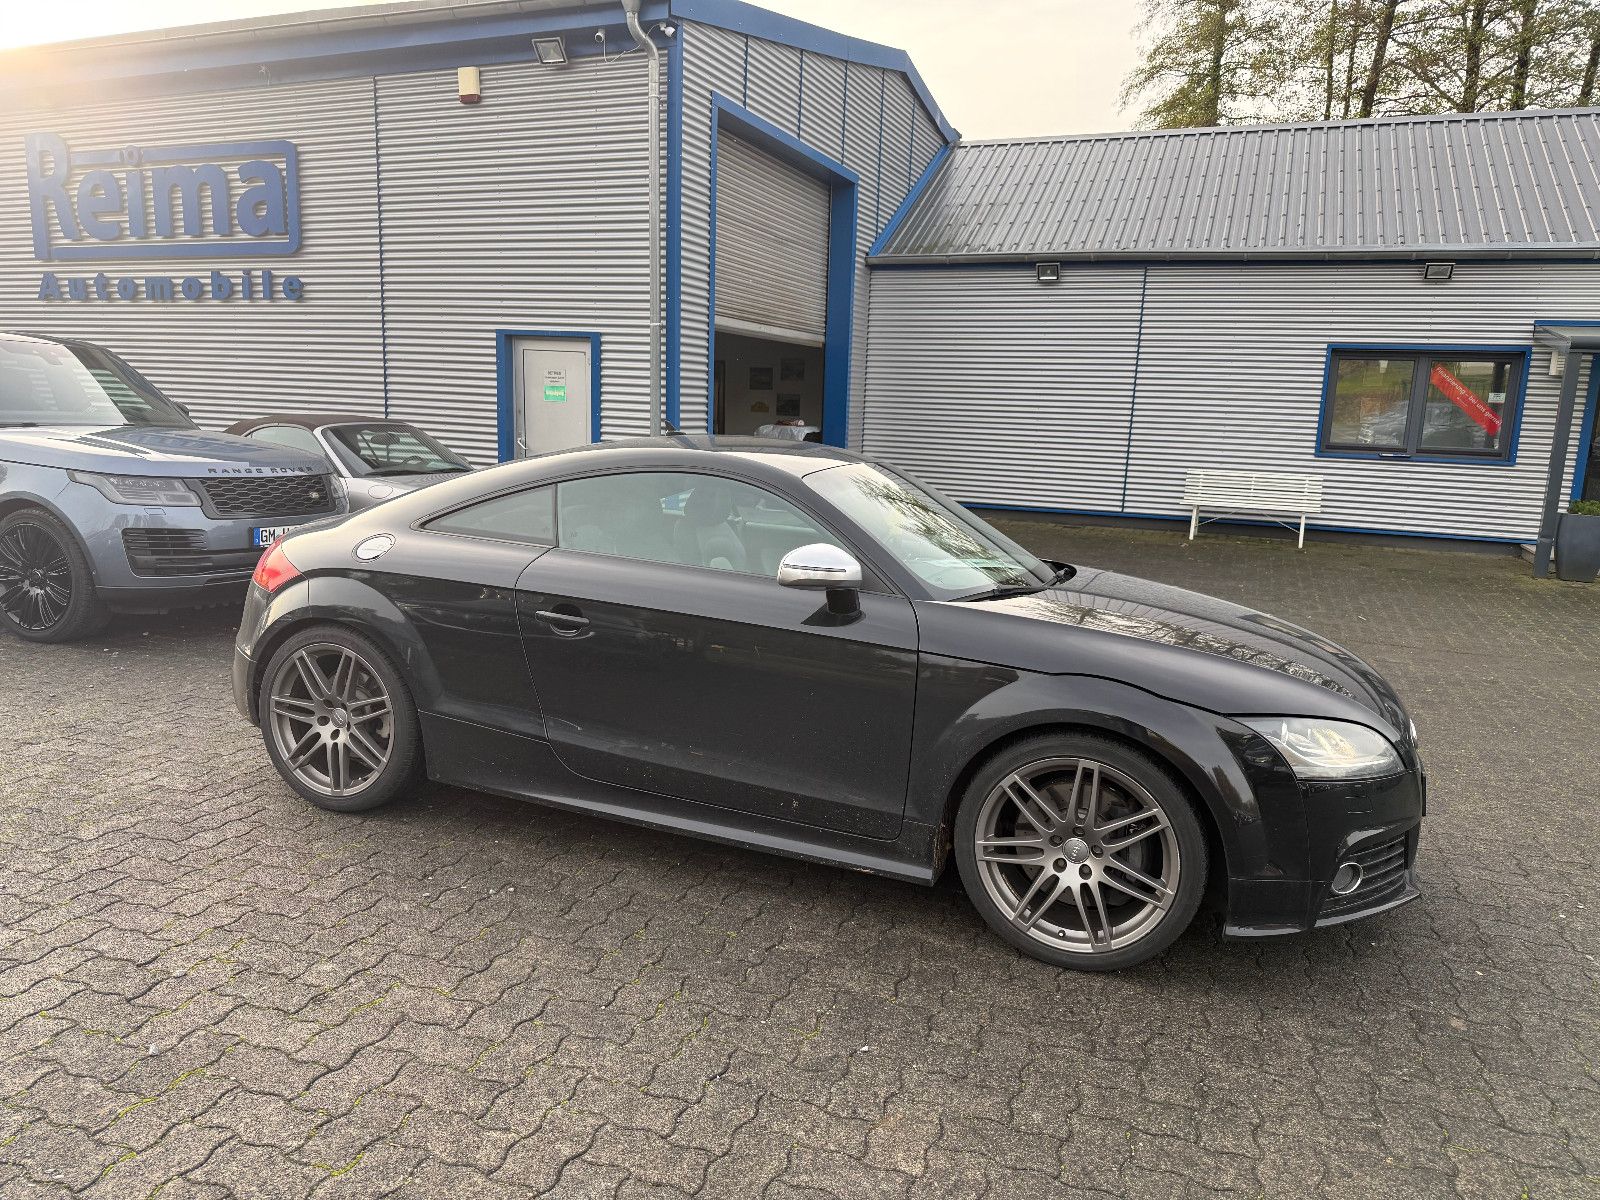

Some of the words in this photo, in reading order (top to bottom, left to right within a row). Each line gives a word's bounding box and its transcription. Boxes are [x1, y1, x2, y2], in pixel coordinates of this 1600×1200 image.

[24, 132, 291, 261] Reima
[38, 269, 305, 302] Automobile
[1436, 366, 1466, 395] Finanzierung
[1468, 395, 1478, 405] bei
[1476, 402, 1487, 413] uns
[260, 528, 276, 543] GM
